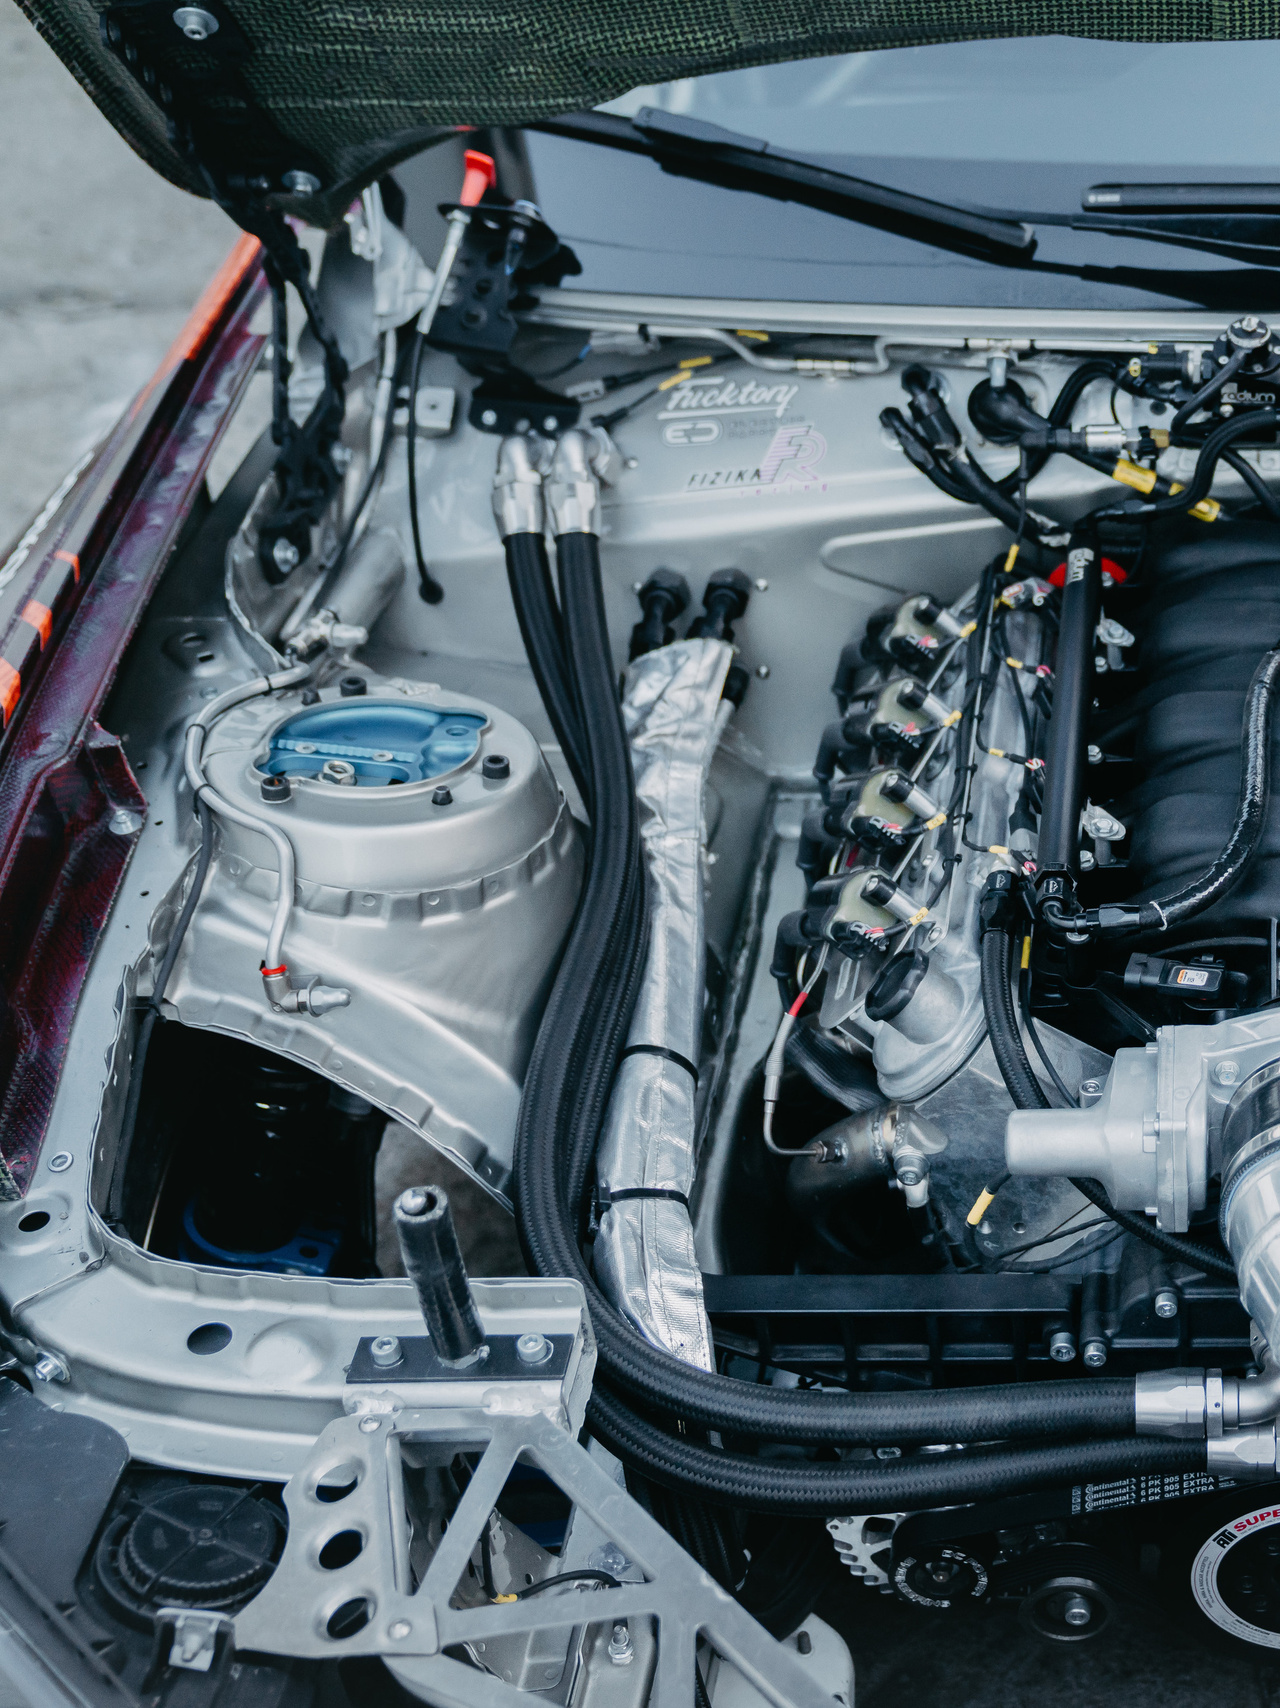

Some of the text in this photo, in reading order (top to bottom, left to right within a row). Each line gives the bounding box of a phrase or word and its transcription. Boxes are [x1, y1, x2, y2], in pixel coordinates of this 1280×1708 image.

[666, 376, 799, 418] Fucktory
[688, 468, 762, 486] FIZIKA
[1085, 1479, 1129, 1493] Continental
[1085, 1486, 1129, 1501] Continental
[1148, 1479, 1161, 1487] PK
[1164, 1475, 1180, 1484] 905
[1085, 1494, 1129, 1509] Continental
[1148, 1487, 1162, 1495] PK
[1164, 1483, 1180, 1492] 905
[1183, 1476, 1215, 1488] EXTRA
[941, 1549, 966, 1561] DC
